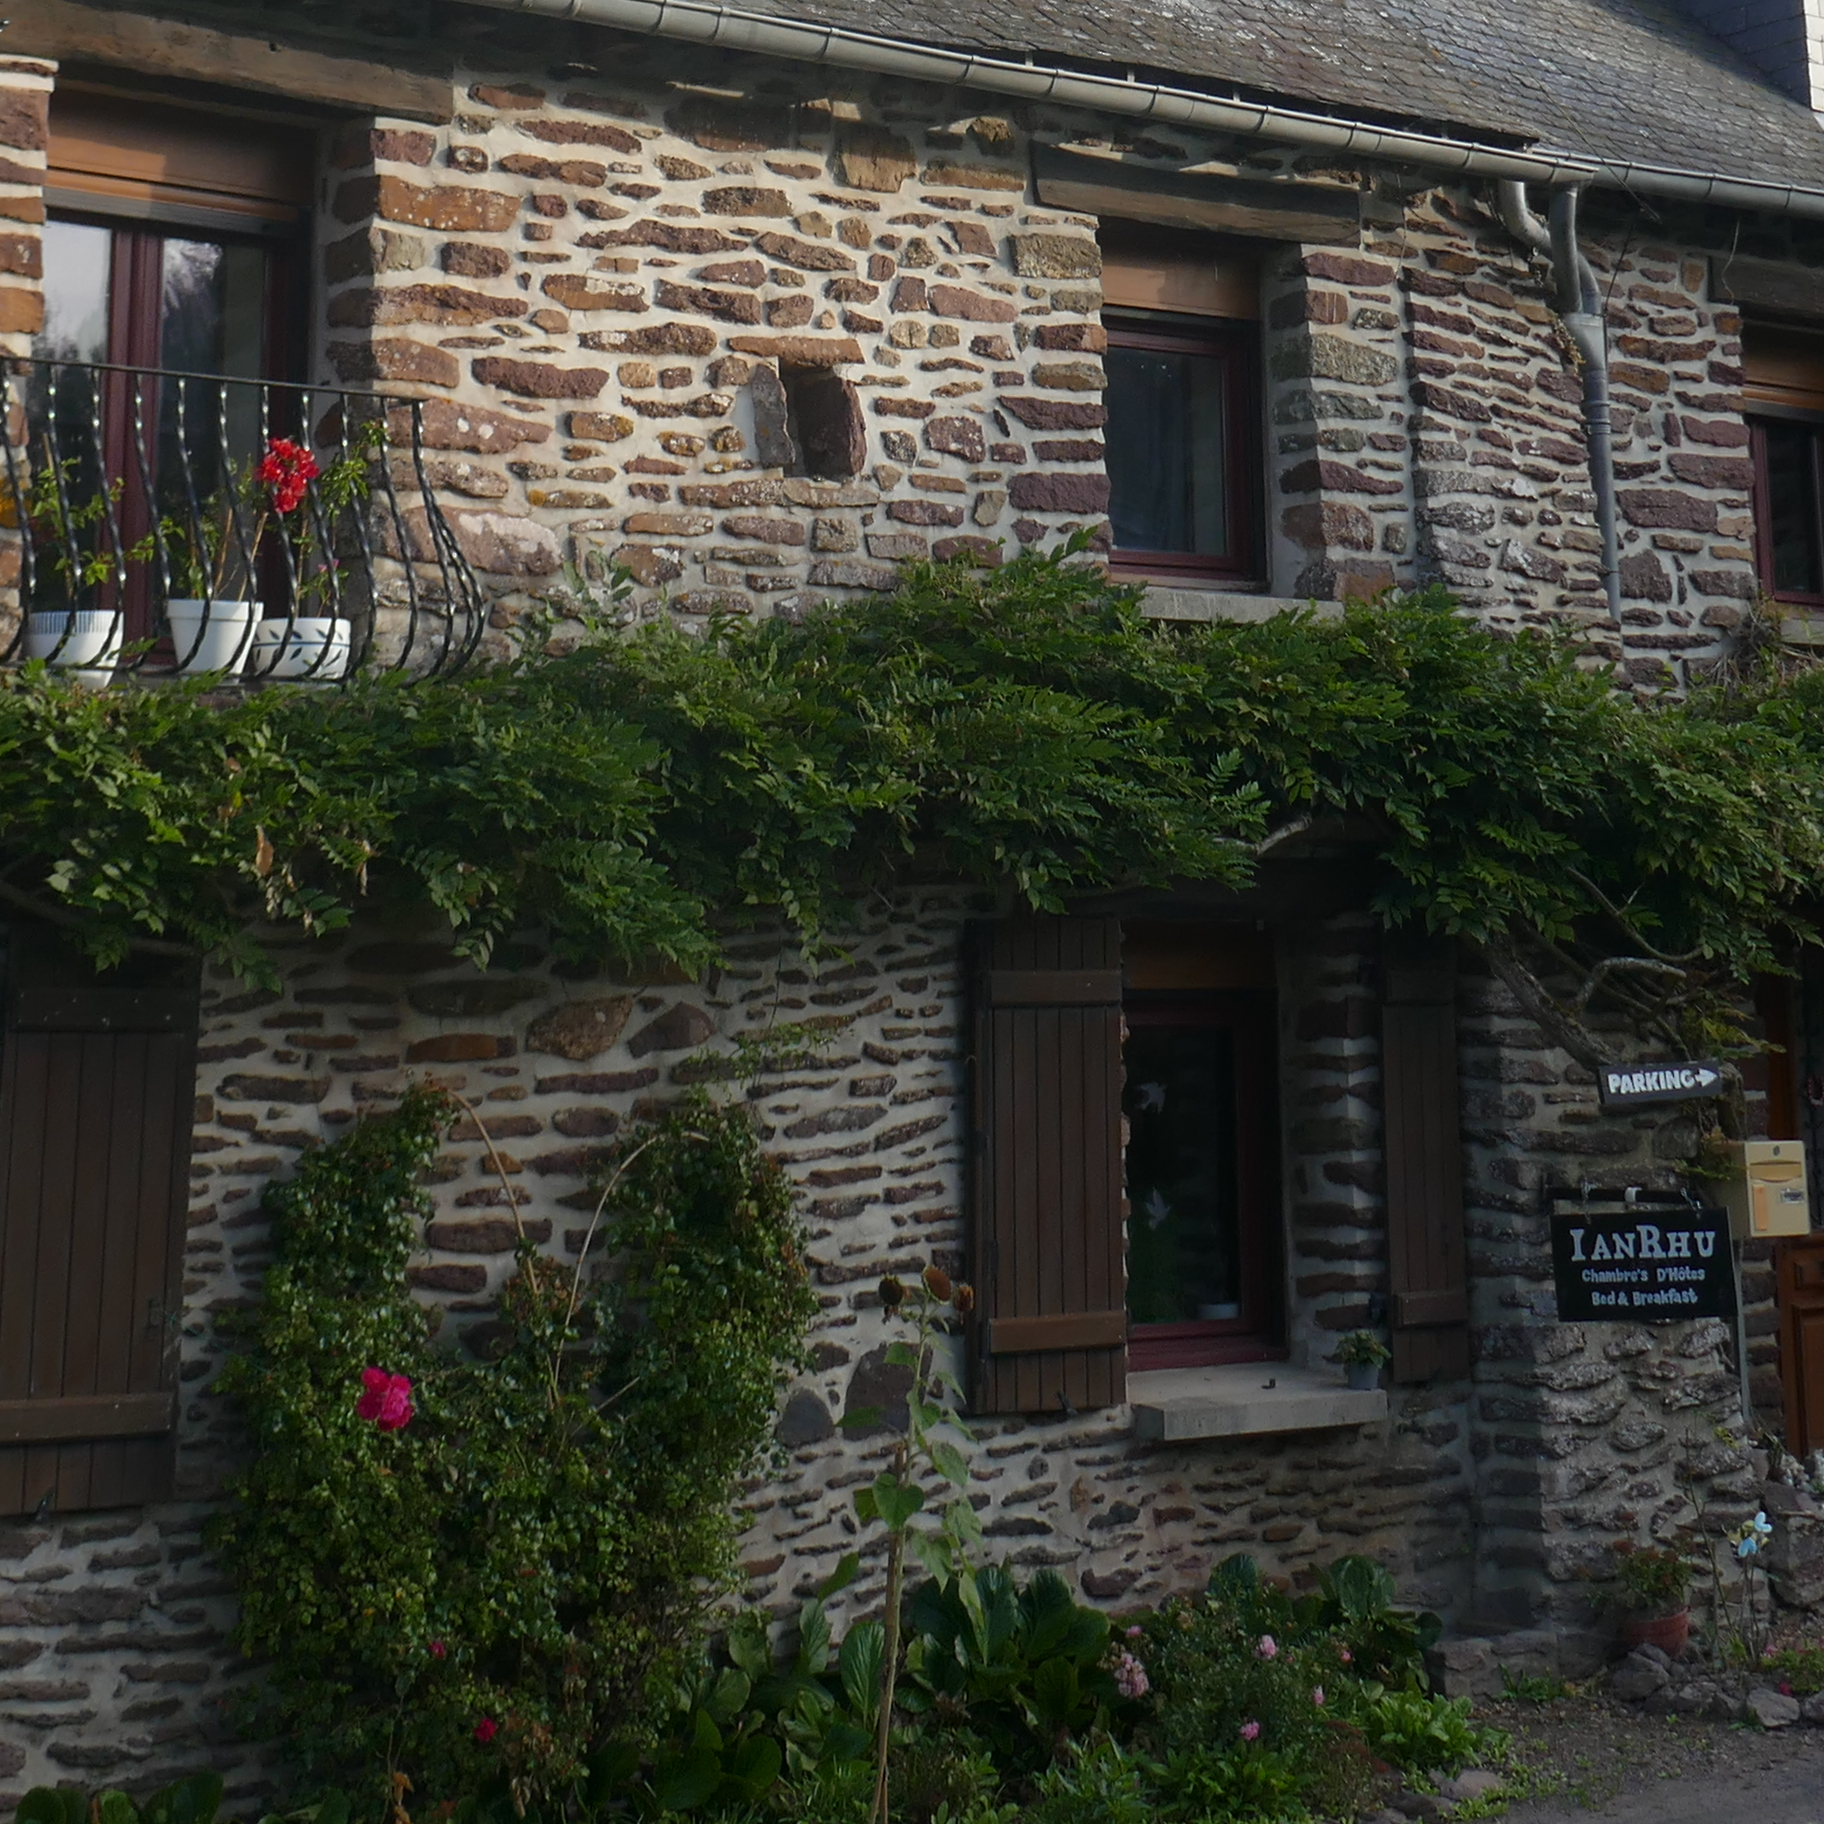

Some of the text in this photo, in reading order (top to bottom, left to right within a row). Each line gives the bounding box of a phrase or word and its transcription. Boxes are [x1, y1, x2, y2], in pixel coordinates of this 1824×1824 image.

[1607, 1068, 1696, 1094] PARKING
[1581, 1265, 1706, 1283] Chambre's D'Hôtes
[1591, 1287, 1699, 1306] Bed & Breakfast
